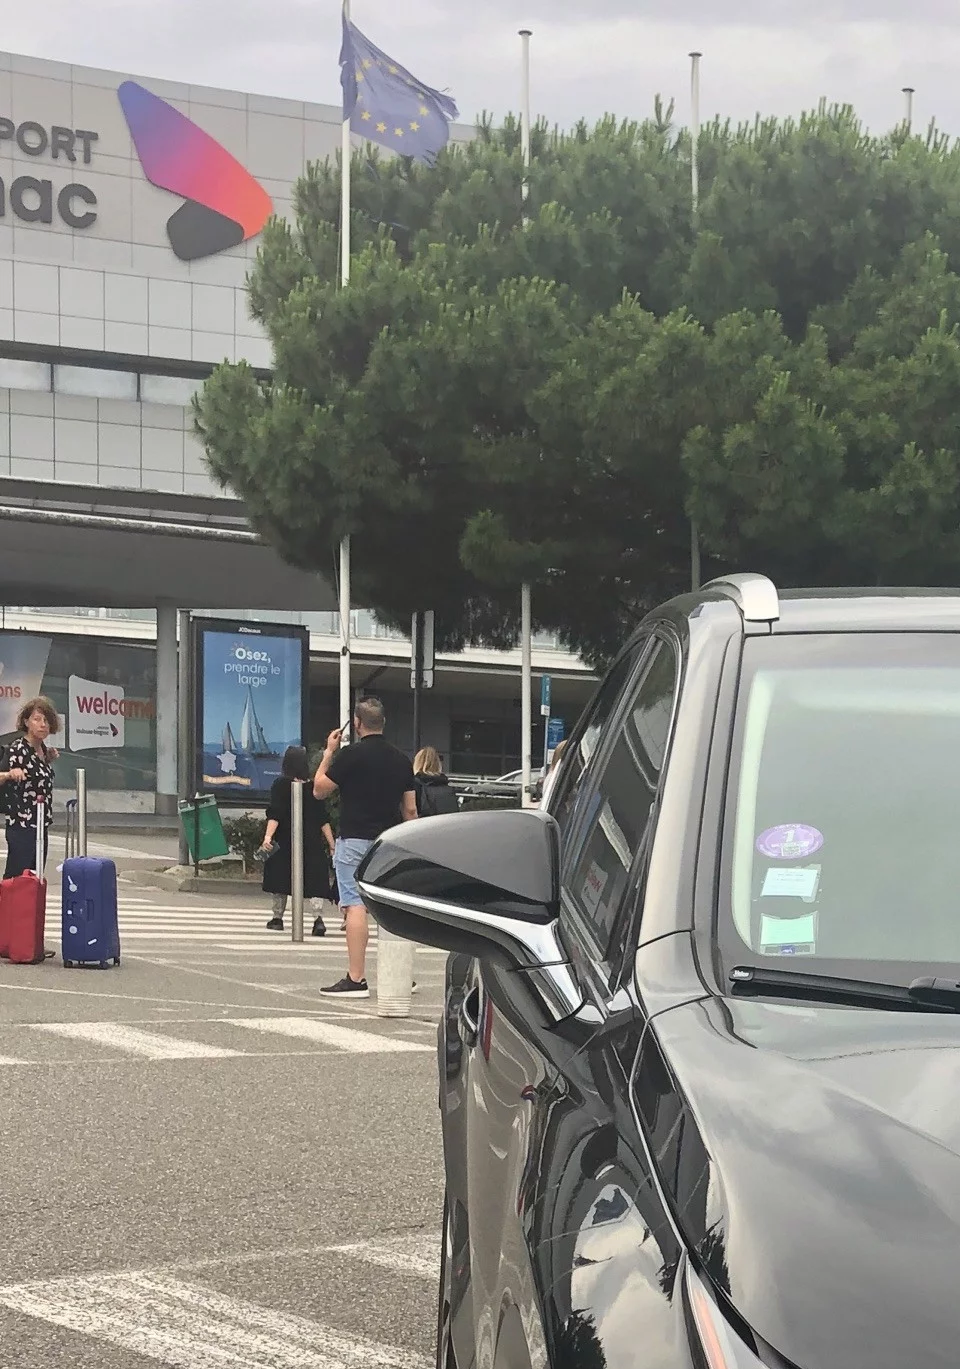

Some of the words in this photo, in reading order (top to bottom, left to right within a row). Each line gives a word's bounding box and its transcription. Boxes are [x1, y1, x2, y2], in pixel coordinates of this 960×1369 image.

[0, 176, 98, 229] ac
[235, 647, 271, 663] Osez,
[224, 663, 268, 674] prendre
[271, 664, 281, 675] le
[238, 674, 267, 687] large
[76, 691, 155, 719] welcome
